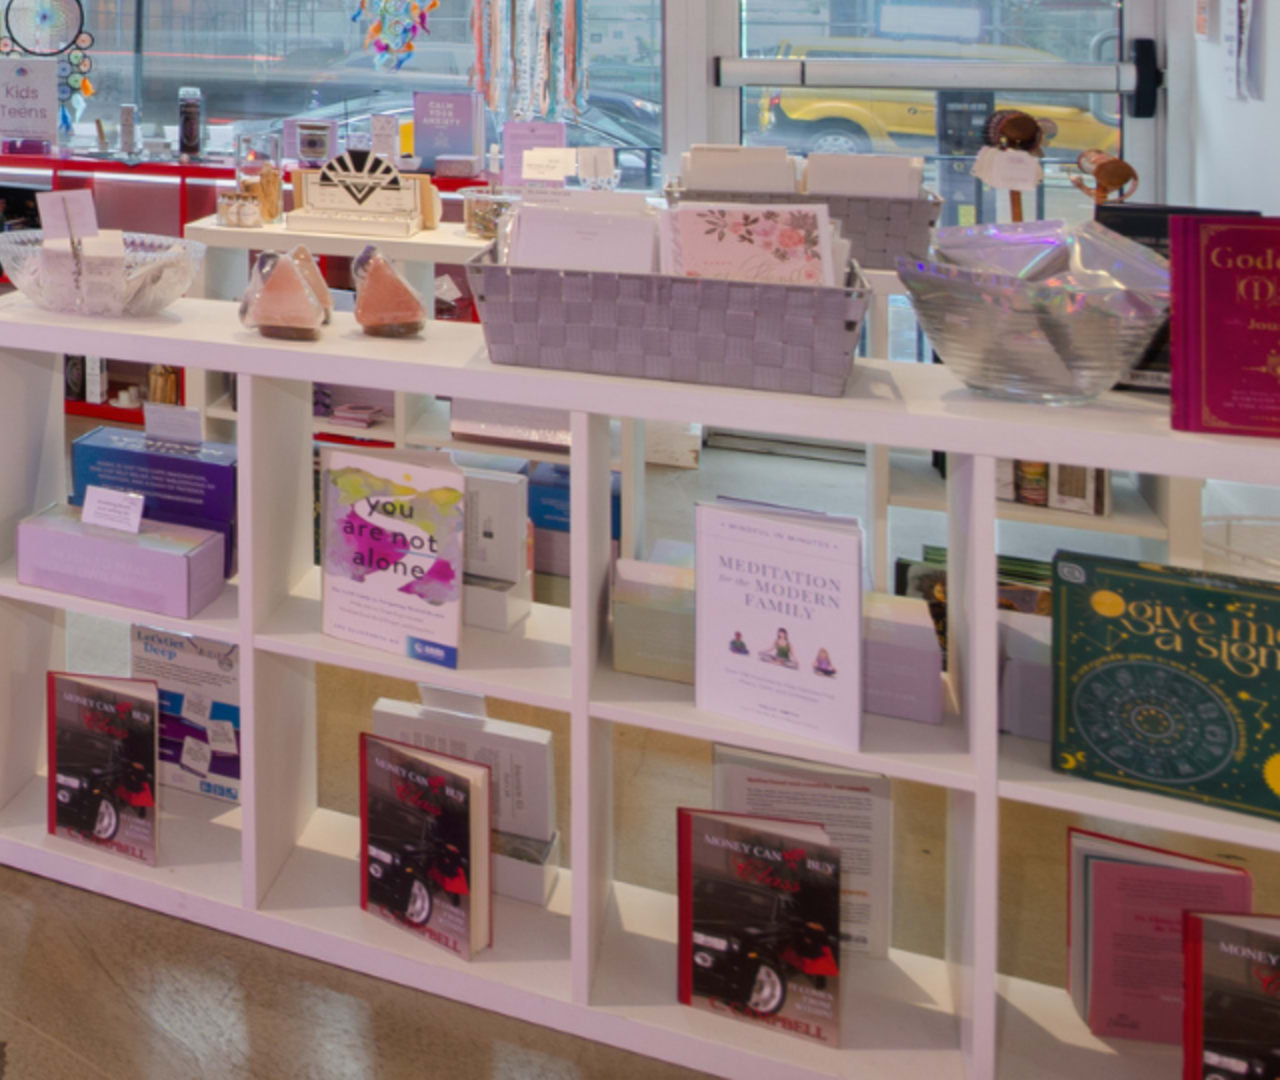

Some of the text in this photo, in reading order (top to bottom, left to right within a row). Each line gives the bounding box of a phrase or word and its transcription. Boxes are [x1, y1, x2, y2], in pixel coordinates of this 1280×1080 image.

[5, 84, 39, 100] Kids
[0, 103, 48, 118] Teens
[365, 496, 414, 519] you
[343, 520, 438, 553] are not
[352, 547, 425, 580] alone
[718, 554, 841, 592] MEDITATION
[744, 592, 816, 620] FAMILY
[755, 578, 841, 609] MODERN
[1119, 599, 1280, 646] give m
[143, 641, 177, 661] Deep
[1154, 626, 1184, 652] a
[1219, 941, 1279, 967] MONEY
